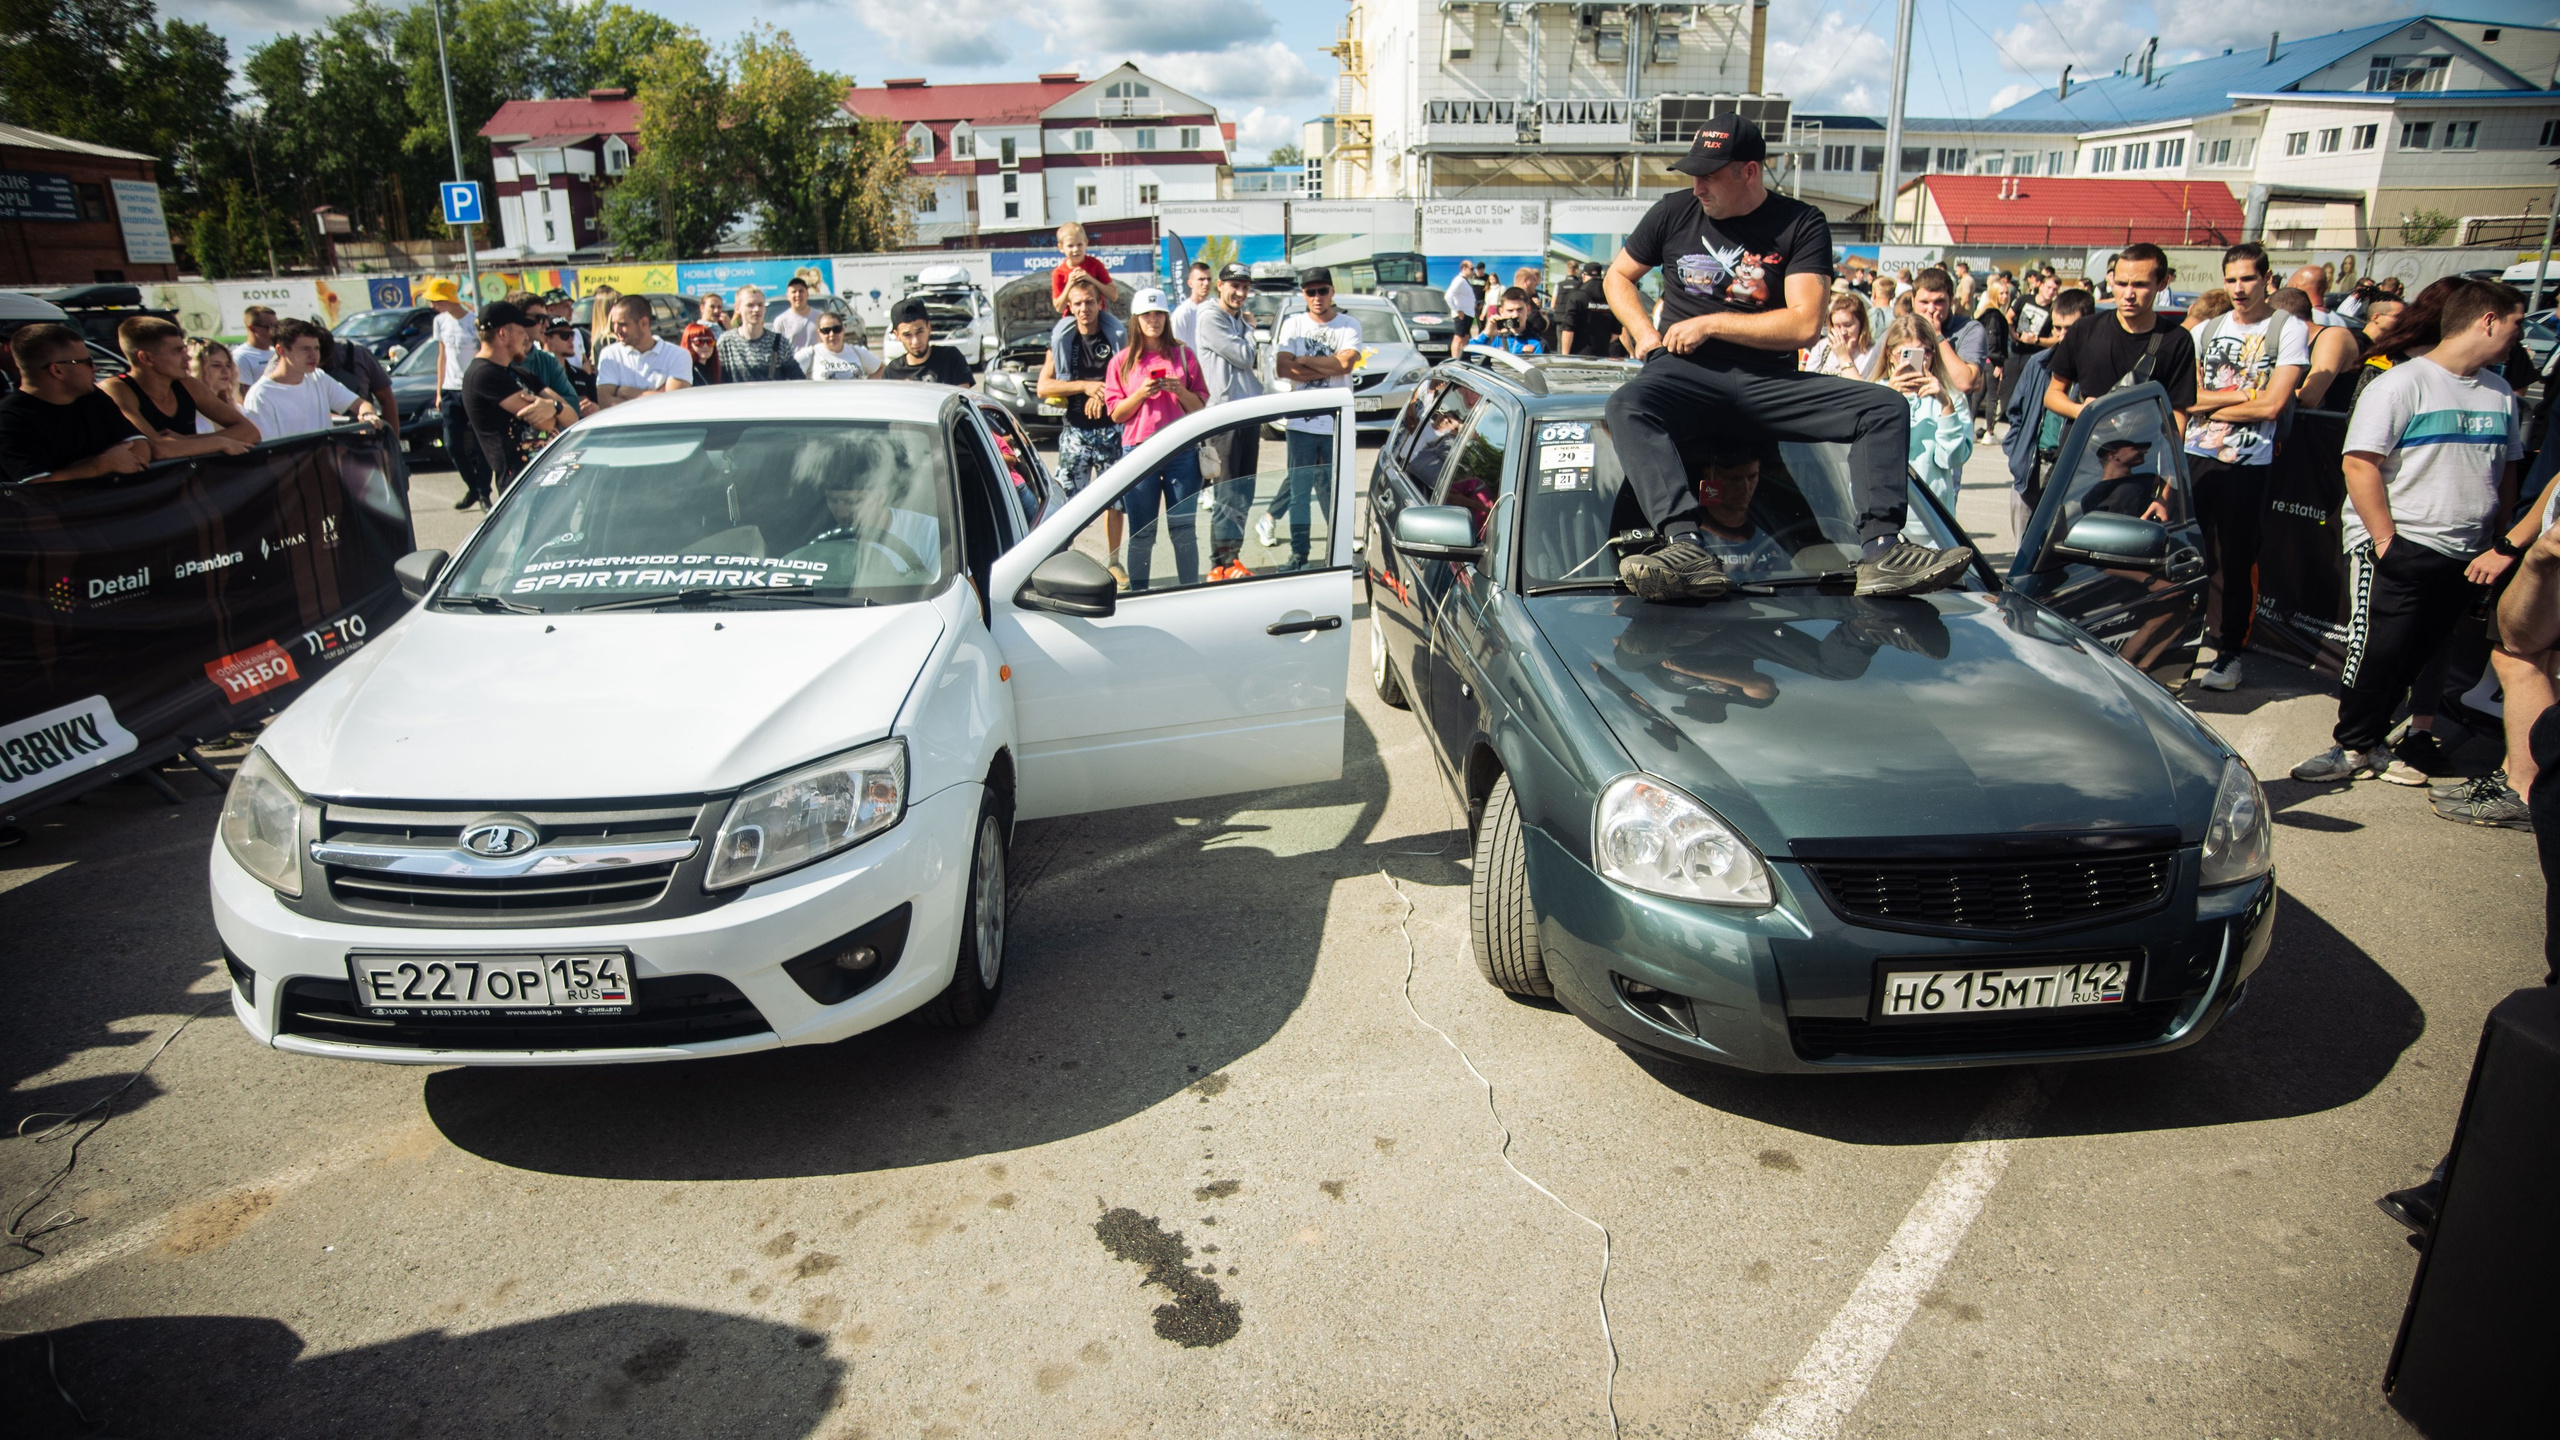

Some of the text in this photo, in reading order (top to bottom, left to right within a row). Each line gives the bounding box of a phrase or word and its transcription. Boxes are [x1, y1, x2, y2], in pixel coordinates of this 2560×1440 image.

[1702, 130, 1729, 139] MASTER
[1703, 140, 1721, 149] FLEX
[452, 187, 473, 218] P
[1211, 206, 1241, 214] ФАСАДЕ
[1294, 206, 1354, 215] Индивидуальный
[1426, 205, 1472, 216] АРЕНДА
[1475, 205, 1488, 214] ОТ
[683, 268, 756, 279] НОВЫЕ ОКНА
[1542, 427, 1585, 441] 093
[1558, 452, 1576, 463] 29
[1560, 475, 1571, 484] 21
[2272, 500, 2327, 520] re:status
[186, 551, 244, 577] Pandora
[523, 555, 828, 574] BROTHERHOOD OF CAR AUDIO
[88, 566, 150, 599] Detail
[511, 569, 824, 594] SPARTAMARKET
[217, 649, 279, 678] оранжевое
[225, 657, 289, 693] НЕБО
[550, 957, 618, 989] 154
[2064, 962, 2122, 992] 142
[568, 989, 600, 1000] RUS
[2072, 991, 2100, 1003] RUS
[431, 1009, 450, 1017] (383)
